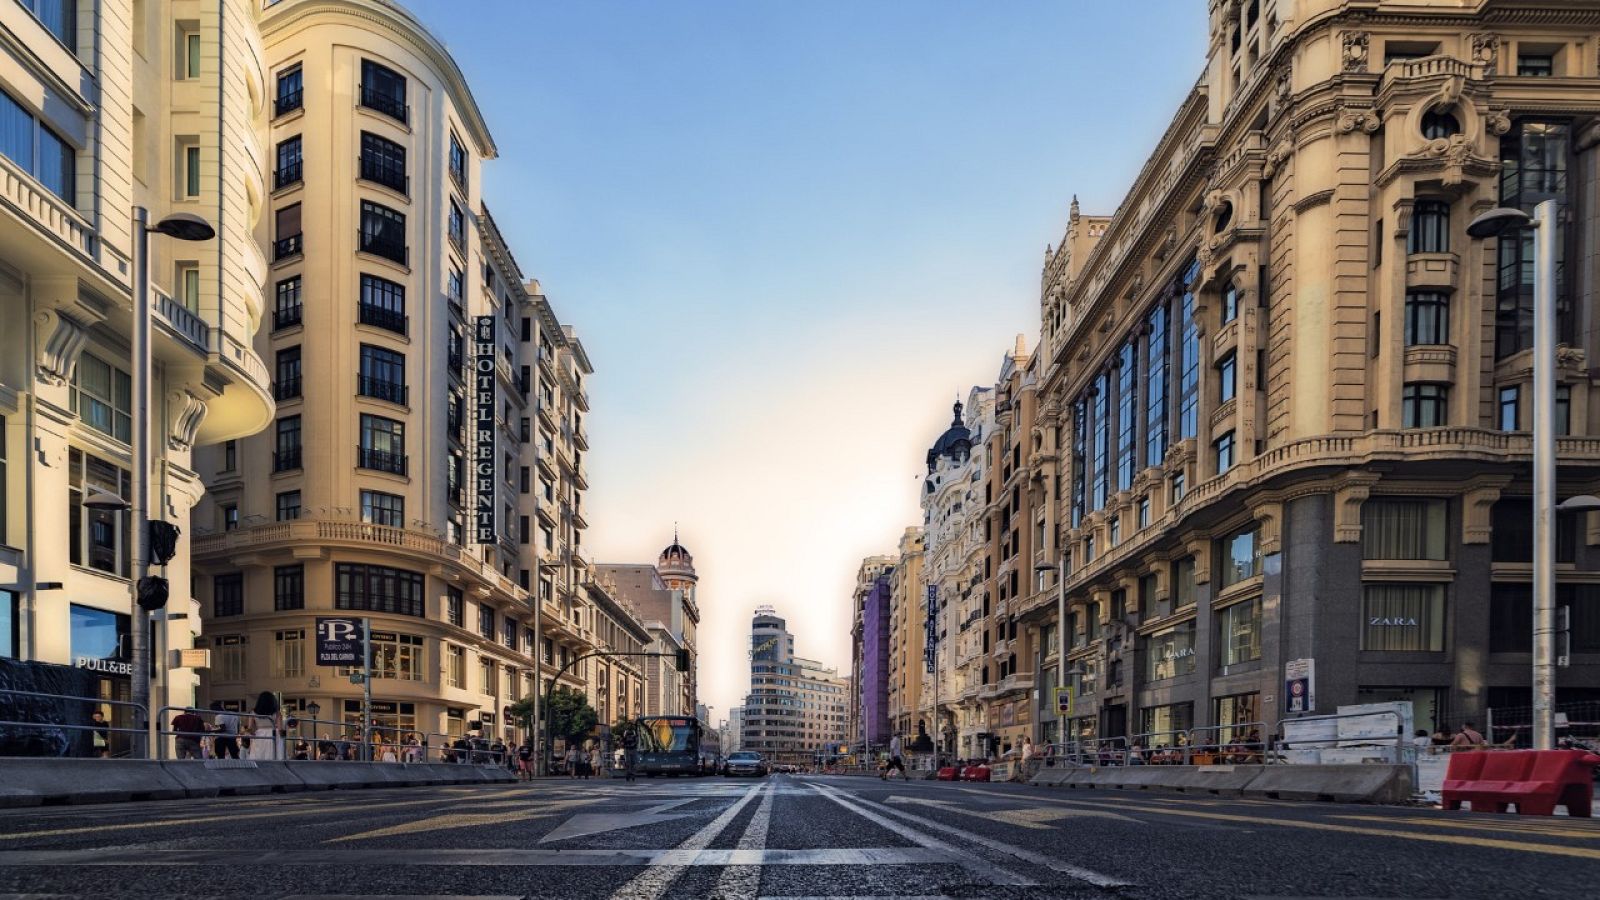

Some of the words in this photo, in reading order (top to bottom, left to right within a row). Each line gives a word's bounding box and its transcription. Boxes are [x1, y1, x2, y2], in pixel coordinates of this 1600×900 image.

[477, 343, 494, 420] HOTEL
[477, 430, 493, 540] REGENTE
[1370, 617, 1418, 626] ZARA
[326, 622, 354, 641] P
[79, 656, 132, 675] PULL&BE
